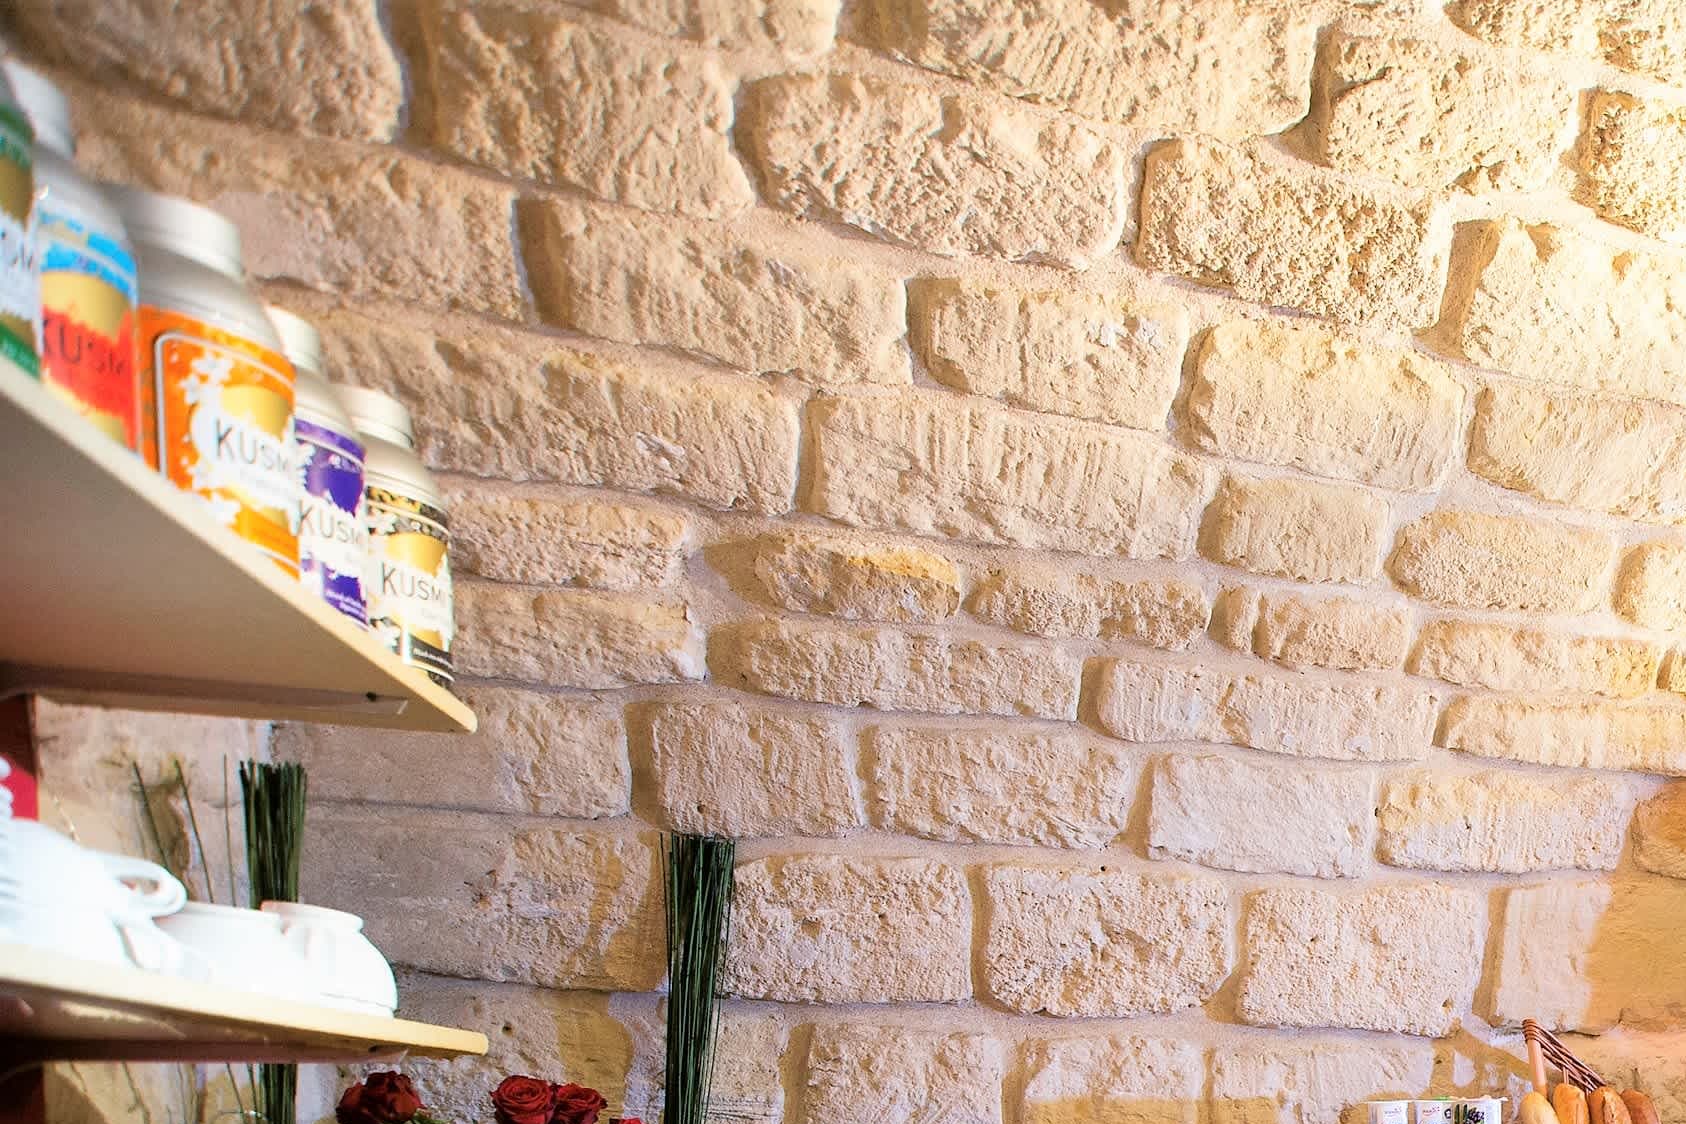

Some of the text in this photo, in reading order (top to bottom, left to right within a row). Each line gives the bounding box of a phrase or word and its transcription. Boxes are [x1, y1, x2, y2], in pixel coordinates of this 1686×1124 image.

[216, 417, 290, 472] KUSM
[297, 498, 364, 545] KUSM
[380, 561, 442, 603] KUSM
